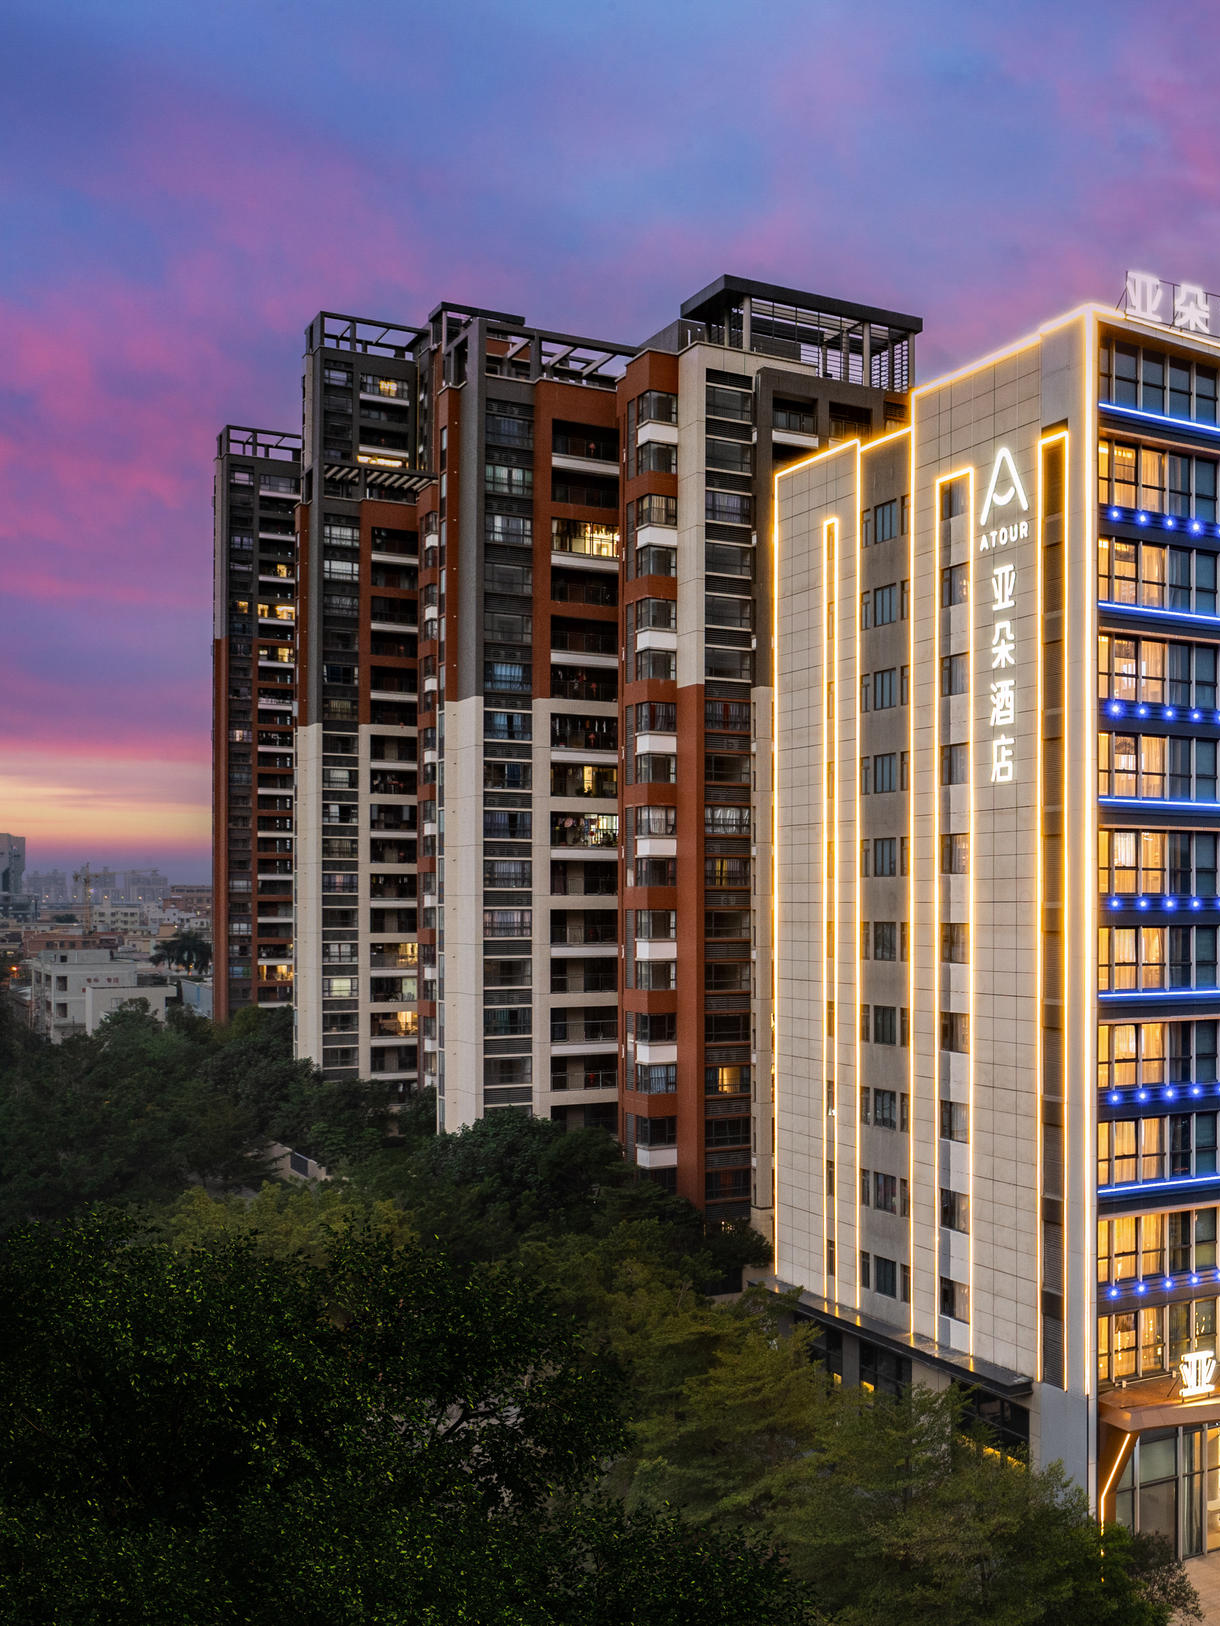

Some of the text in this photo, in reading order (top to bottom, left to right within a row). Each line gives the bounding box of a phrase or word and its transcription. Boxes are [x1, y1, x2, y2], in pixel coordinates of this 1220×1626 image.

[980, 521, 1029, 551] ATOUR
[990, 564, 1016, 783] 亚朵酒店
